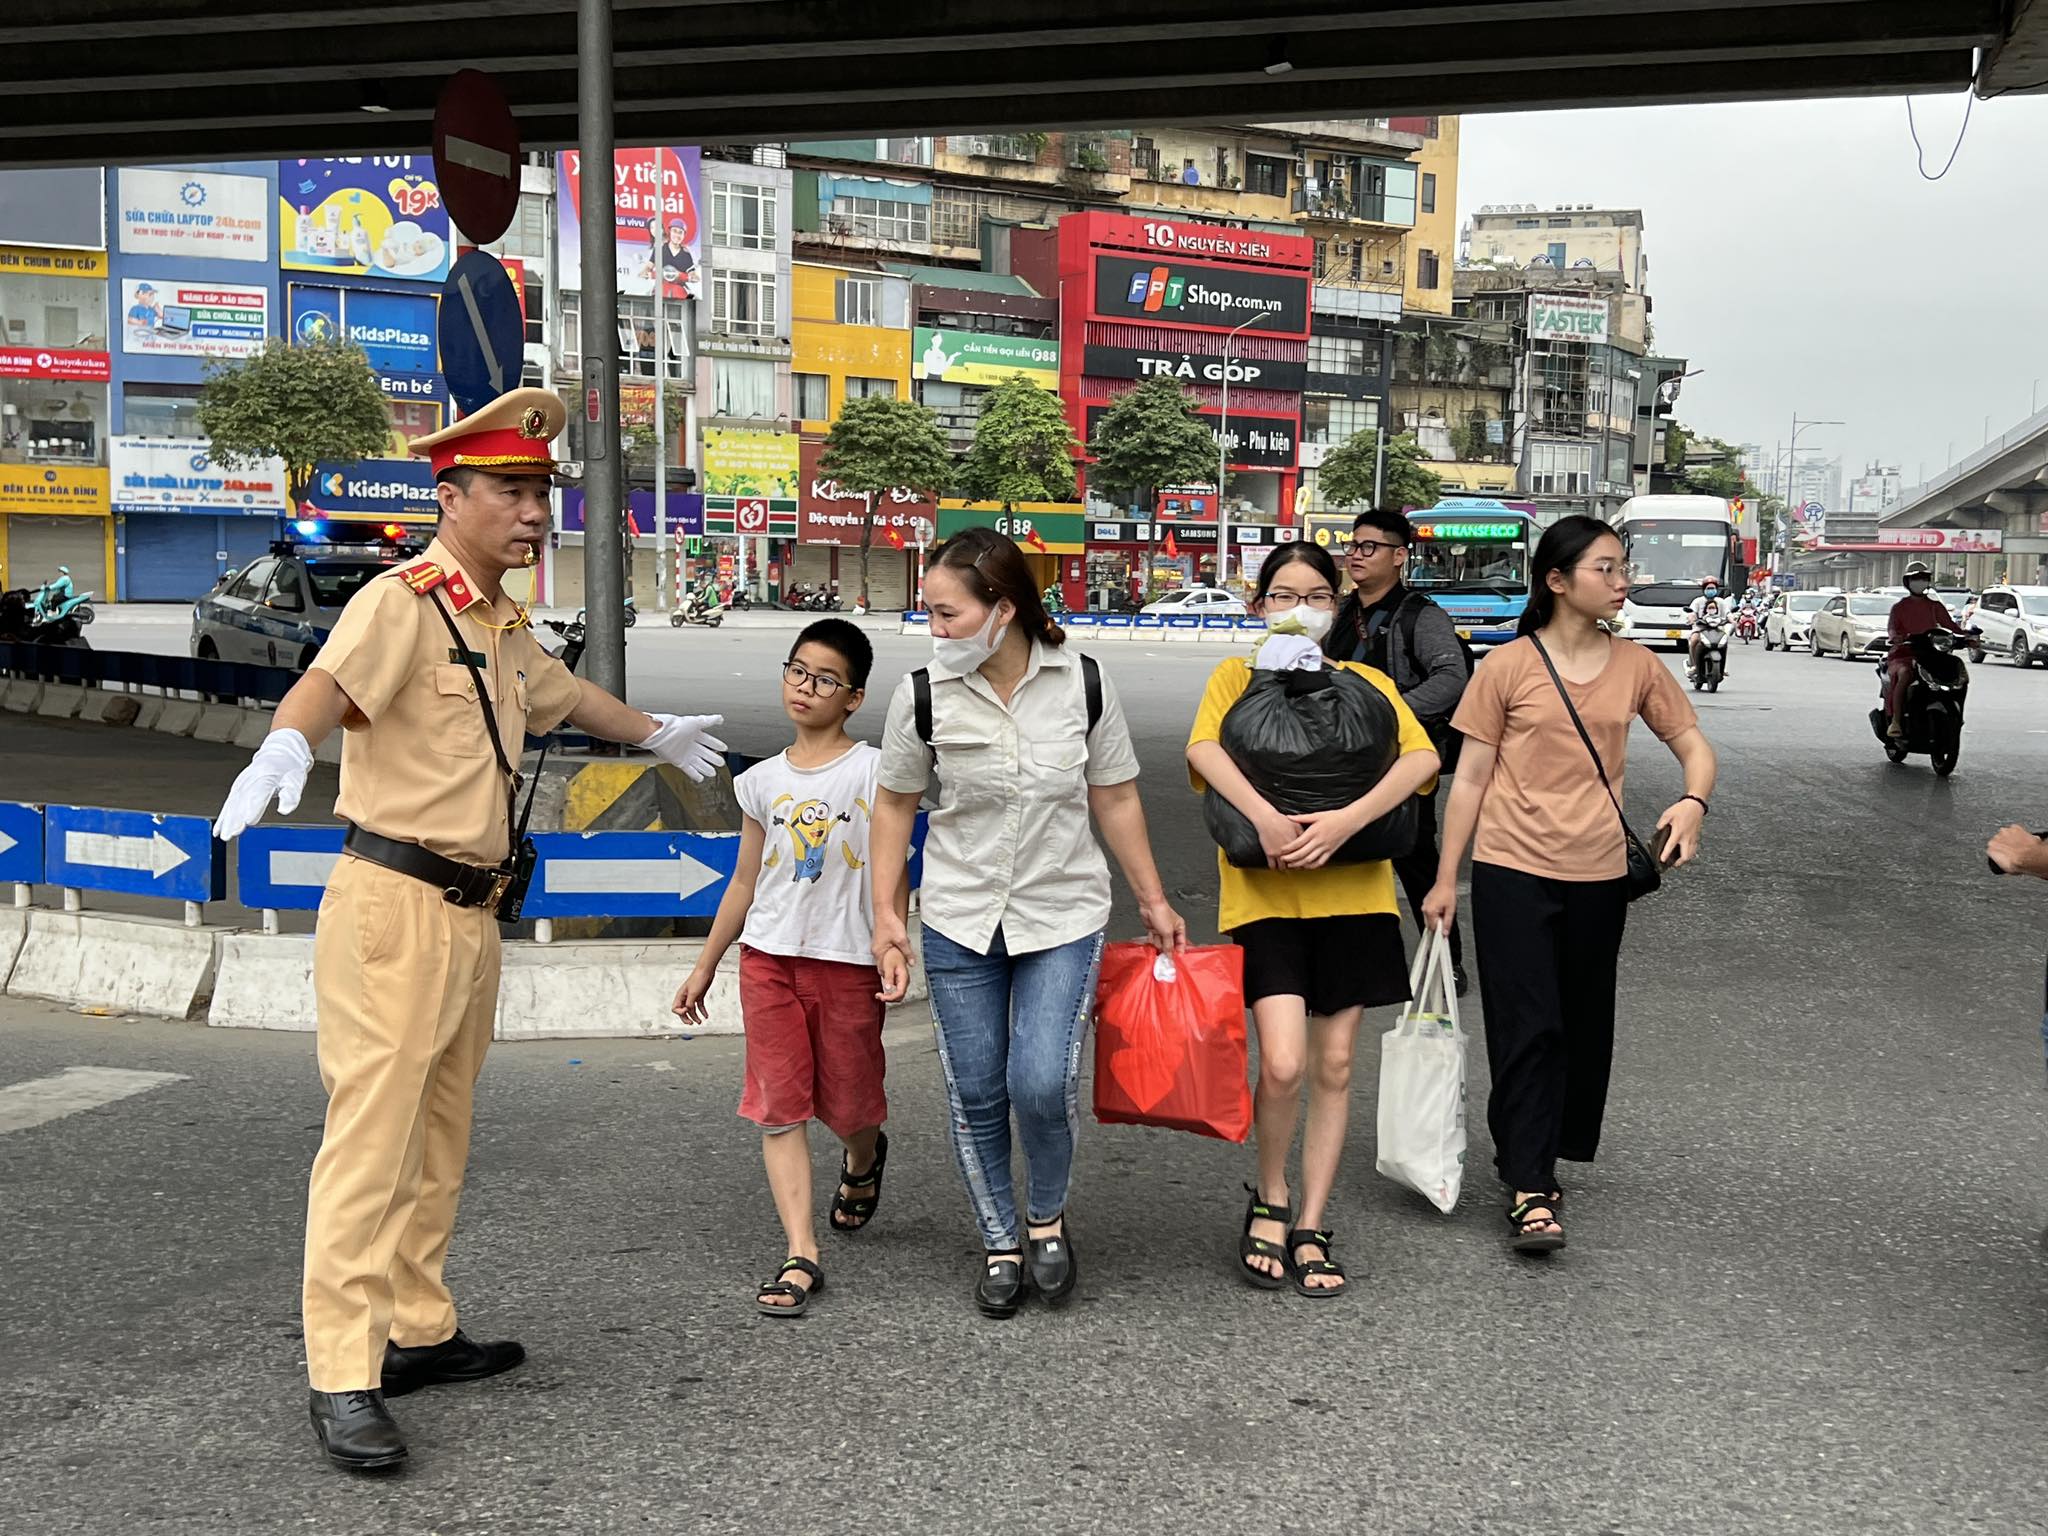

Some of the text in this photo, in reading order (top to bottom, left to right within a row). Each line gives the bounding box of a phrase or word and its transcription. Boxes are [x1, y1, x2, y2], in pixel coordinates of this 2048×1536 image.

[177, 214, 213, 226] LAPTOP
[1143, 223, 1174, 247] 10
[1187, 284, 1282, 312] Shop.com.vn
[1534, 308, 1602, 333] FASTER
[350, 326, 430, 345] KidsPlaza
[1136, 354, 1261, 382] TRẢ GÓP
[381, 377, 433, 394] Em bé
[1249, 431, 1268, 455] Phụ
[1270, 431, 1290, 456] kiện
[180, 478, 223, 490] LAPTOP
[348, 479, 438, 501] KidsPlaza
[1181, 529, 1218, 539] SAMSUNG
